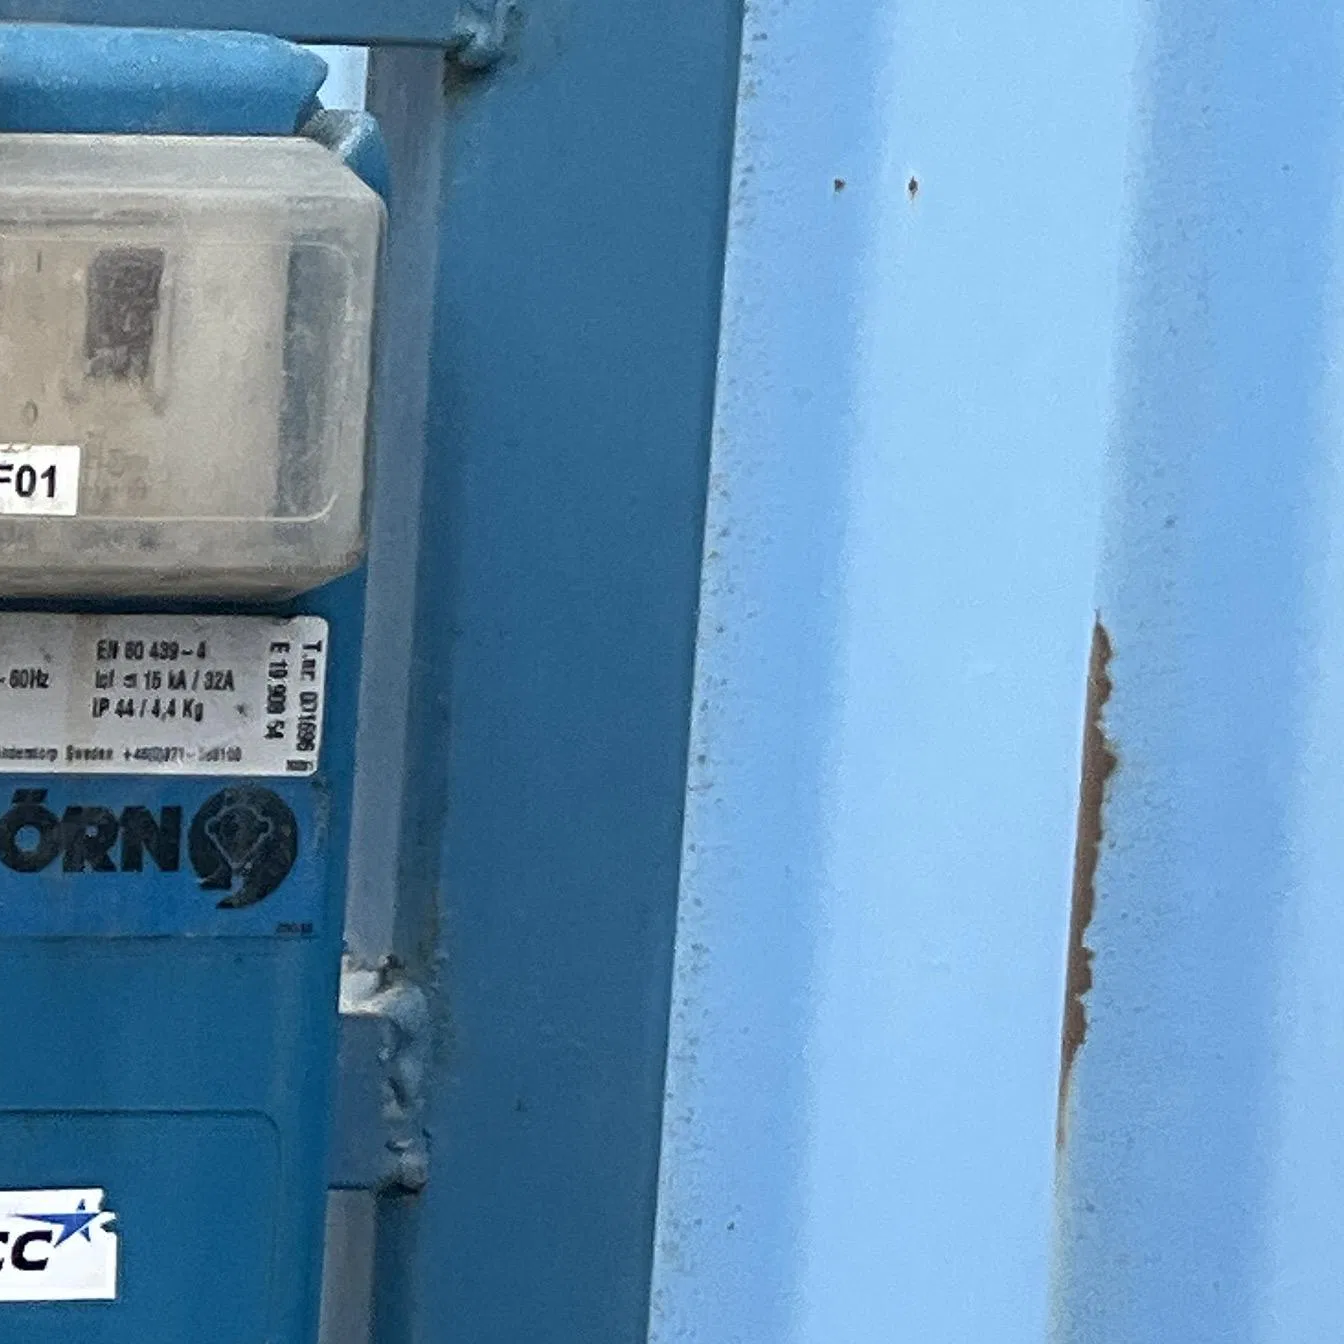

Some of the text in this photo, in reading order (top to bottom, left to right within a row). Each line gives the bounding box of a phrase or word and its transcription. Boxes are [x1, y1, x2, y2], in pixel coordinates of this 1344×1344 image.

[144, 669, 162, 690] 15
[204, 669, 235, 691] 32A
[92, 697, 110, 718] IP
[114, 698, 134, 718] 44
